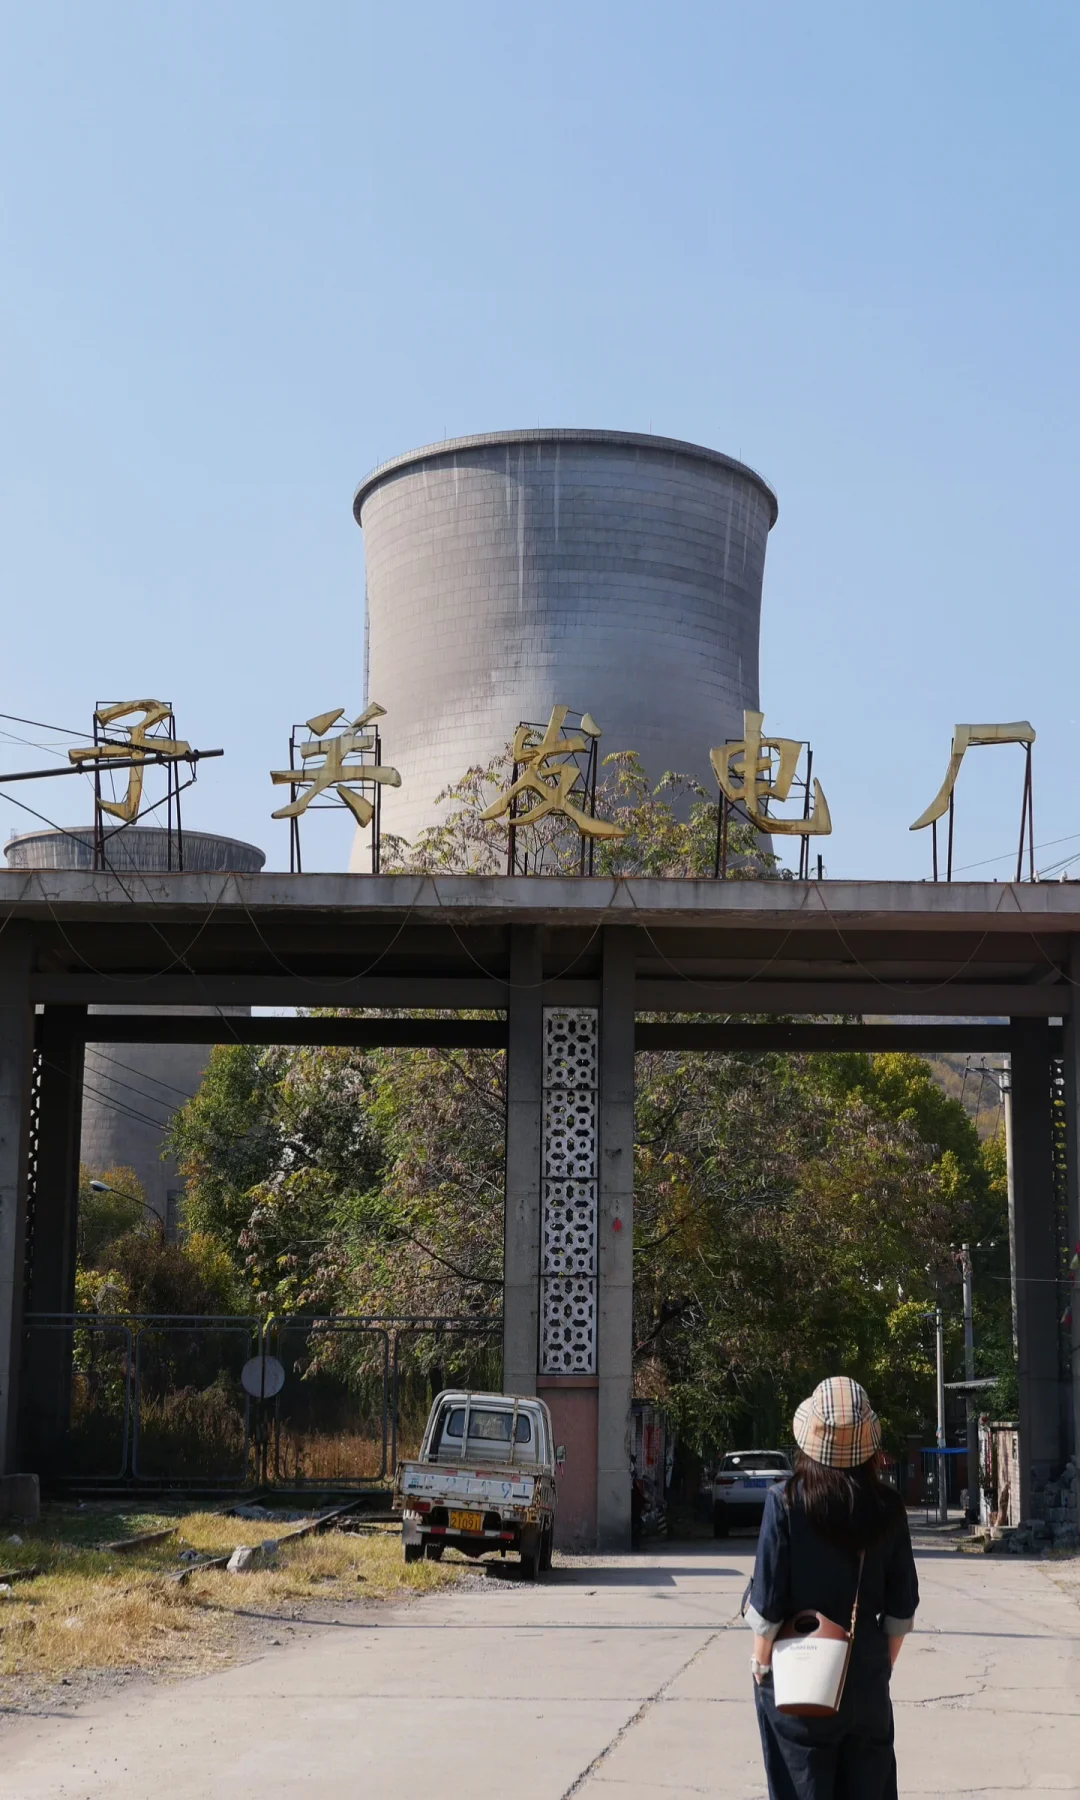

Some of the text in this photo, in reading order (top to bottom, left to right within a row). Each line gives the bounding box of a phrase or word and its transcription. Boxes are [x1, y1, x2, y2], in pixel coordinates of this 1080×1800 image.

[68, 698, 1036, 838] 子关发电厂
[451, 1517, 479, 1530] 21091
